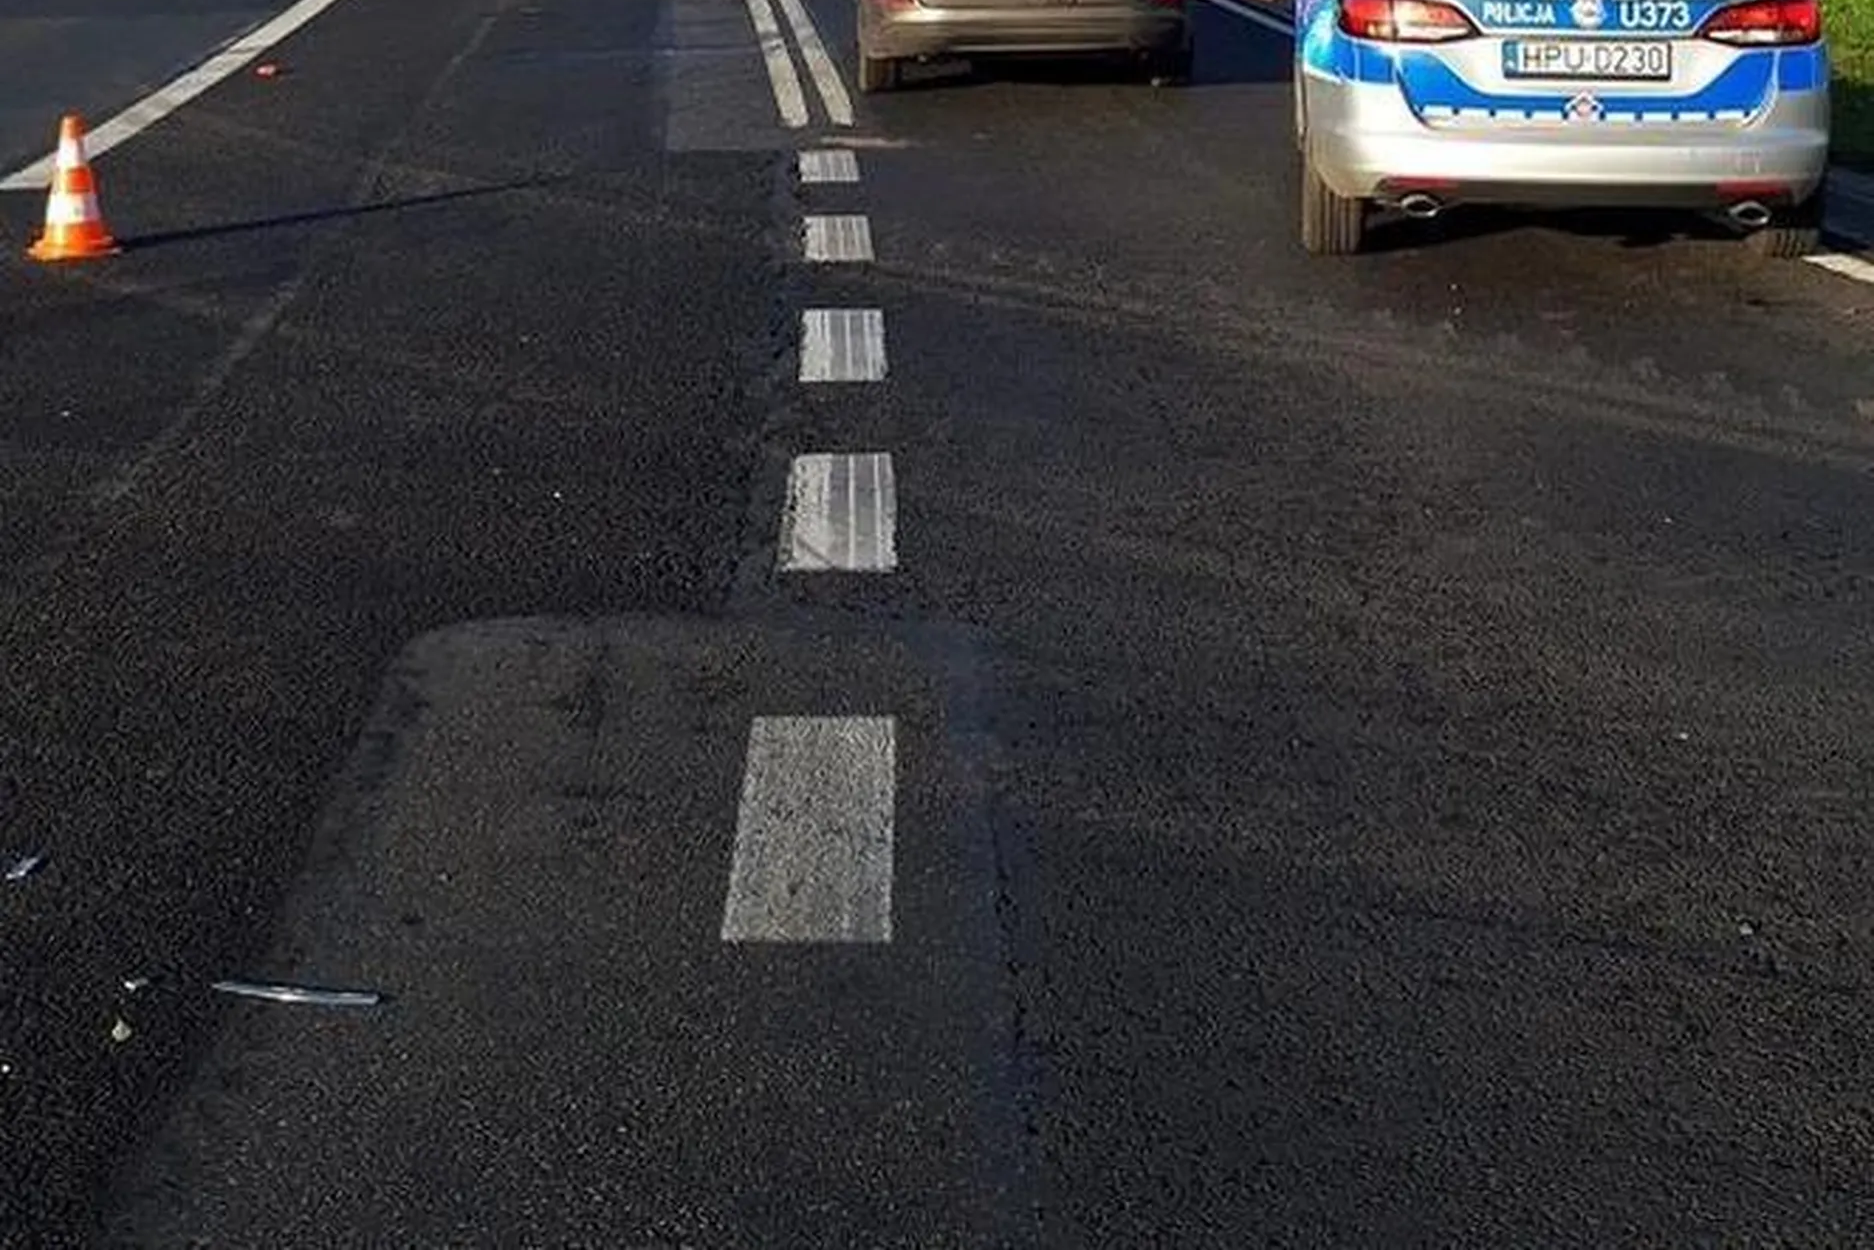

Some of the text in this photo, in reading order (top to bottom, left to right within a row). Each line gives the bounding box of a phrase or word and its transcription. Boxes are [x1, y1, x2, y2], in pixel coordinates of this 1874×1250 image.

[1482, 1, 1691, 28] POLICJA U373
[1523, 45, 1585, 71] HPU
[1594, 46, 1664, 73] D230
